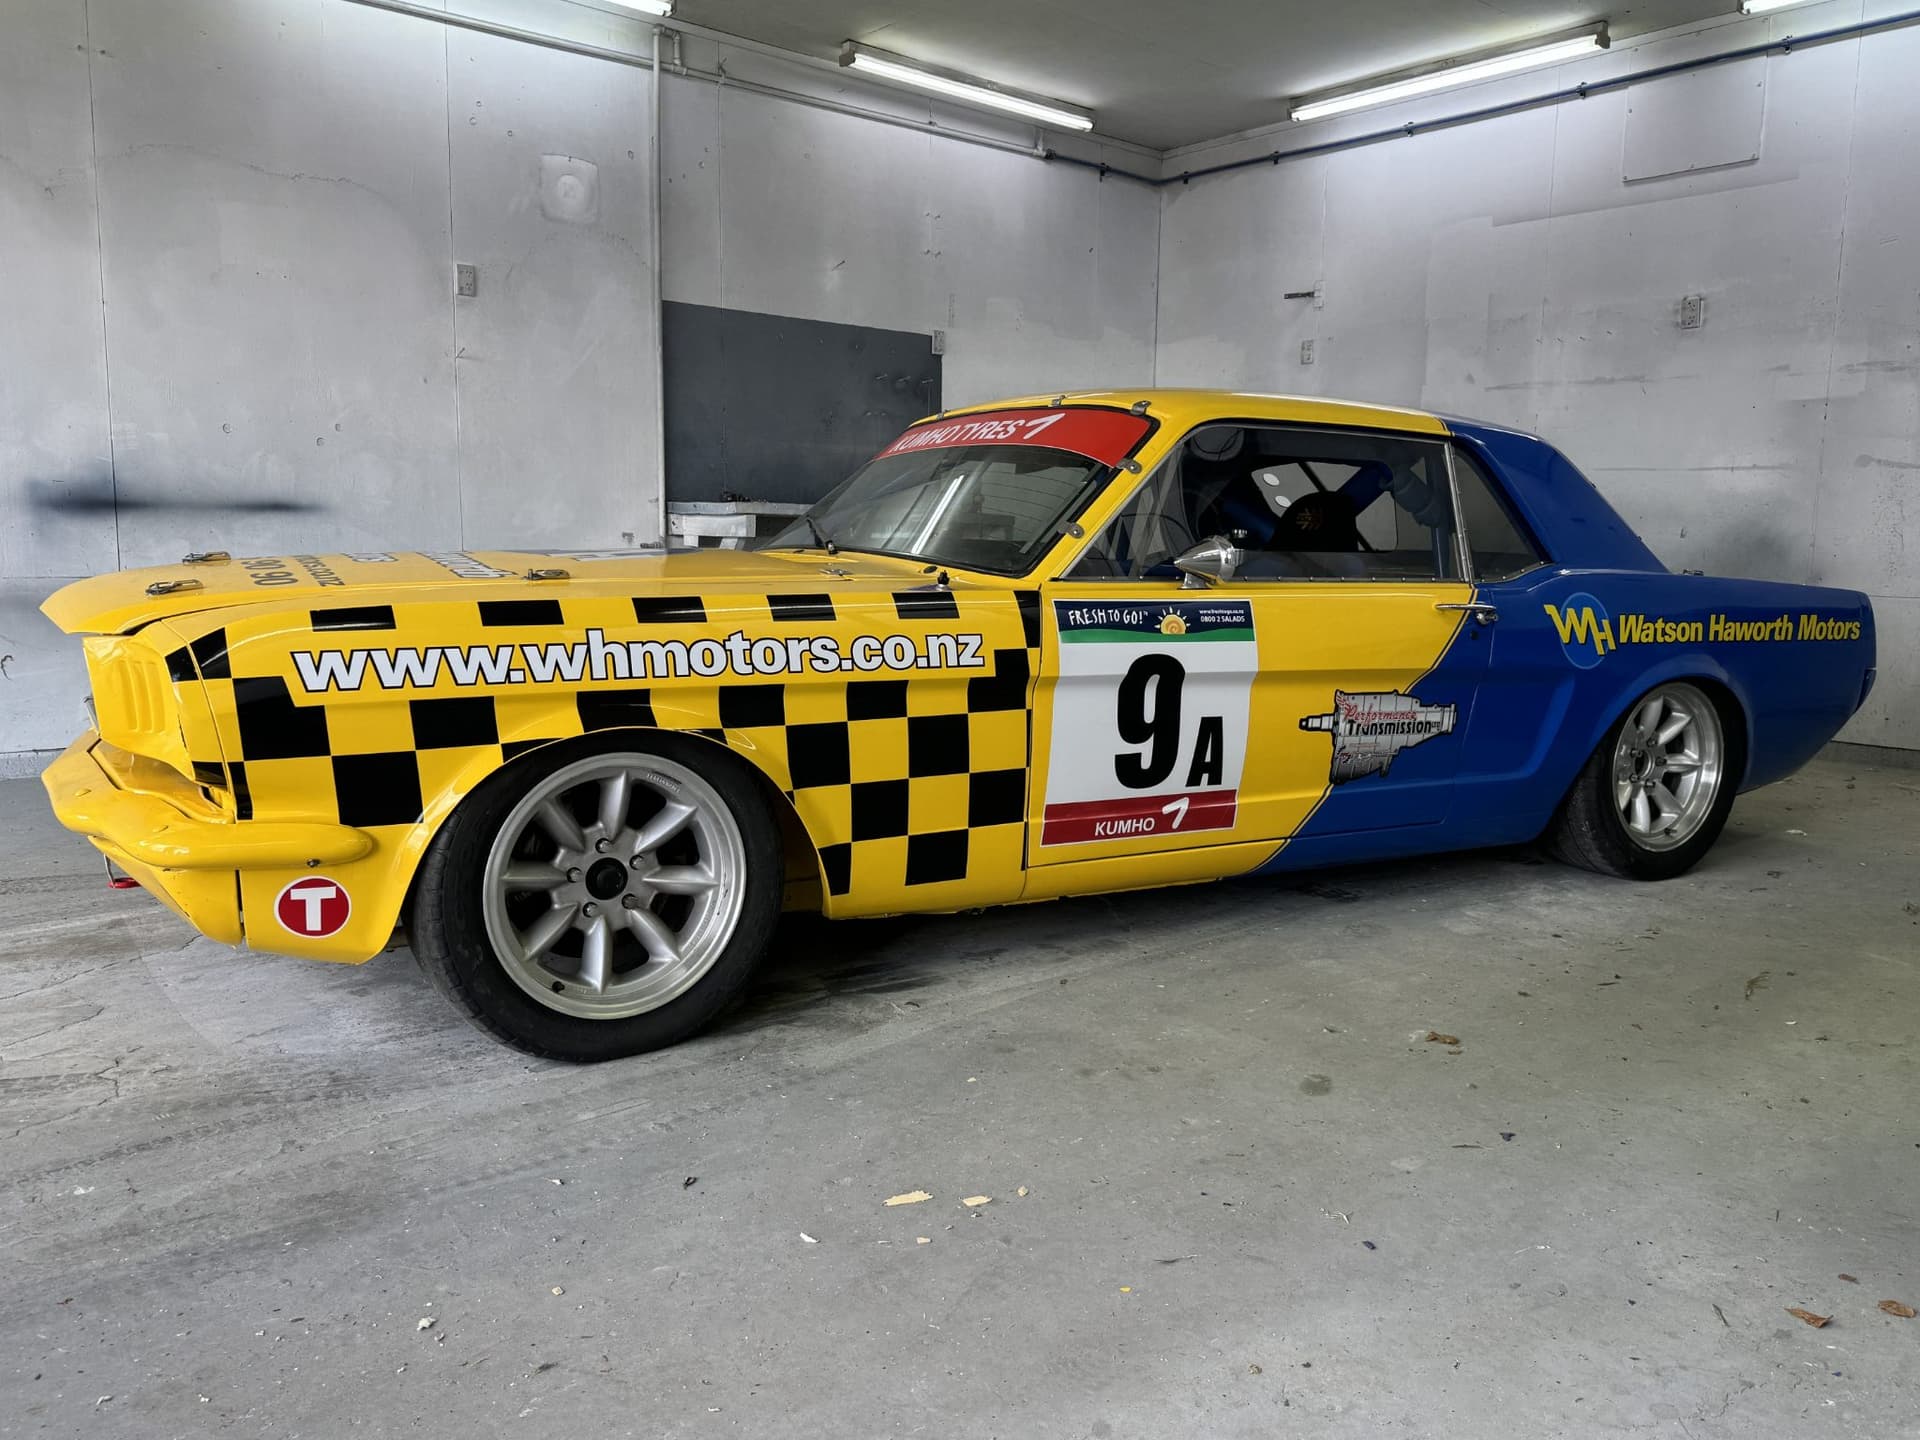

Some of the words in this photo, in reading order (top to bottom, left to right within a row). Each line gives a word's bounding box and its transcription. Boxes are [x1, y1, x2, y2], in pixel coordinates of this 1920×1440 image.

[889, 425, 958, 452] KUMHO
[957, 420, 1025, 440] TYRES
[1068, 608, 1107, 625] FRESH
[1107, 609, 1120, 622] TO
[1200, 615, 1216, 623] 0800
[1221, 615, 1246, 623] SALADS
[1619, 613, 1703, 644] Watson
[1709, 613, 1793, 642] Haworth
[1797, 613, 1861, 641] Motors
[291, 628, 984, 692] www.whmotors.co.nz
[1344, 703, 1417, 726] Performance
[1348, 719, 1432, 736] Transmission
[1095, 817, 1155, 836] KUMHO
[290, 886, 337, 931] T
